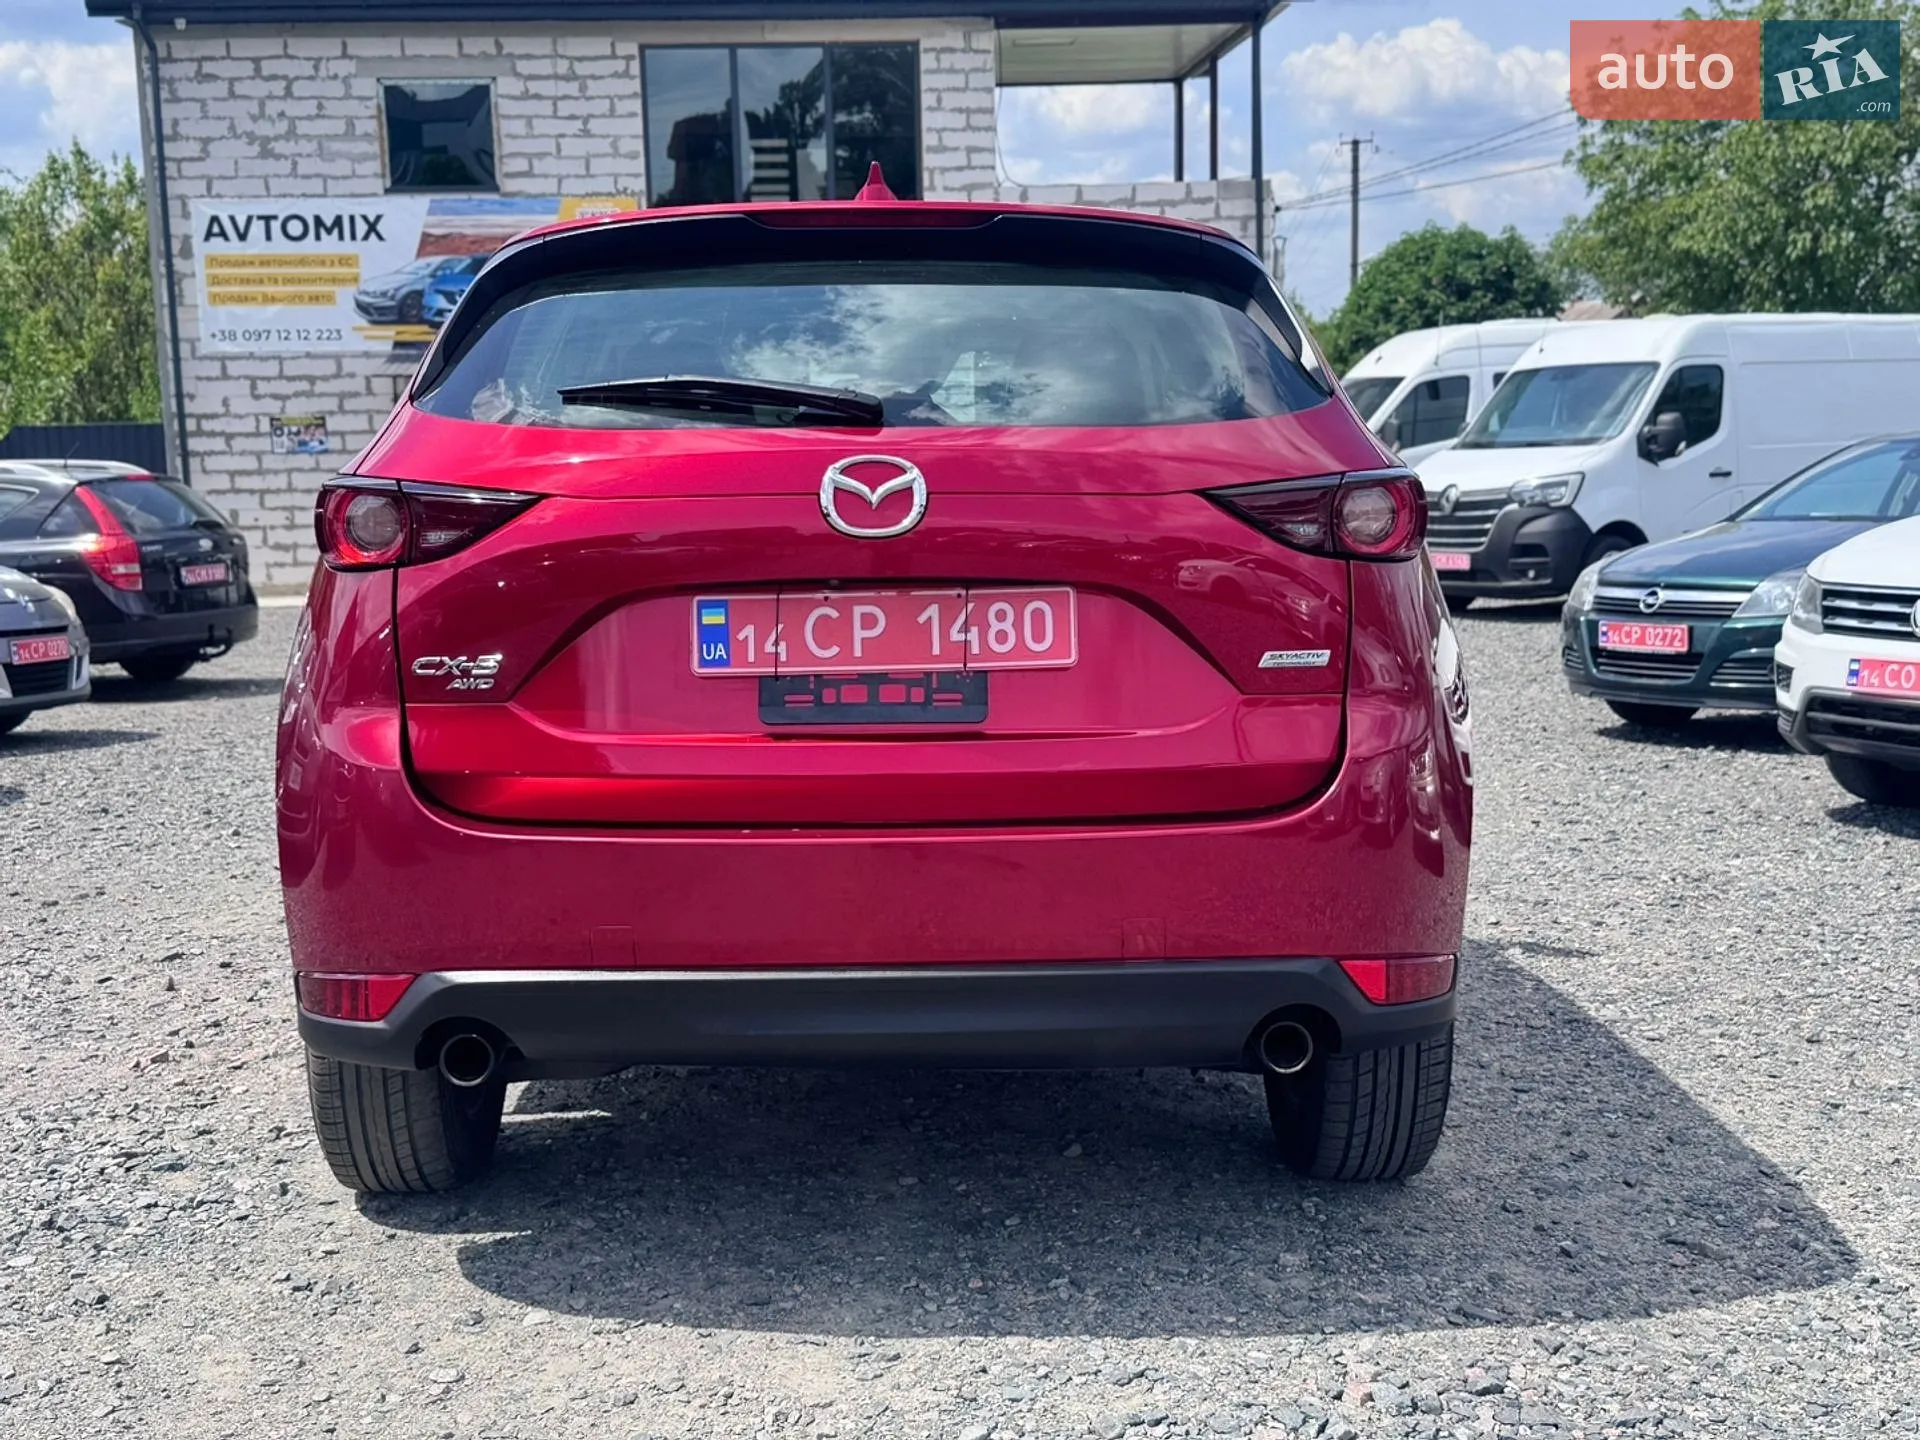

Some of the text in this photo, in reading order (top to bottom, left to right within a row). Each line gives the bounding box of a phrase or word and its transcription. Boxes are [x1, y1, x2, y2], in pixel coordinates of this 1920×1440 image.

[203, 214, 386, 242] AVTOMIX
[210, 329, 343, 341] +38 097 12 12 223
[735, 599, 1054, 663] 14 CP 1480
[1645, 627, 1683, 647] 0272
[702, 643, 727, 660] UA
[411, 654, 503, 675] CX-5
[1862, 668, 1880, 686] 14
